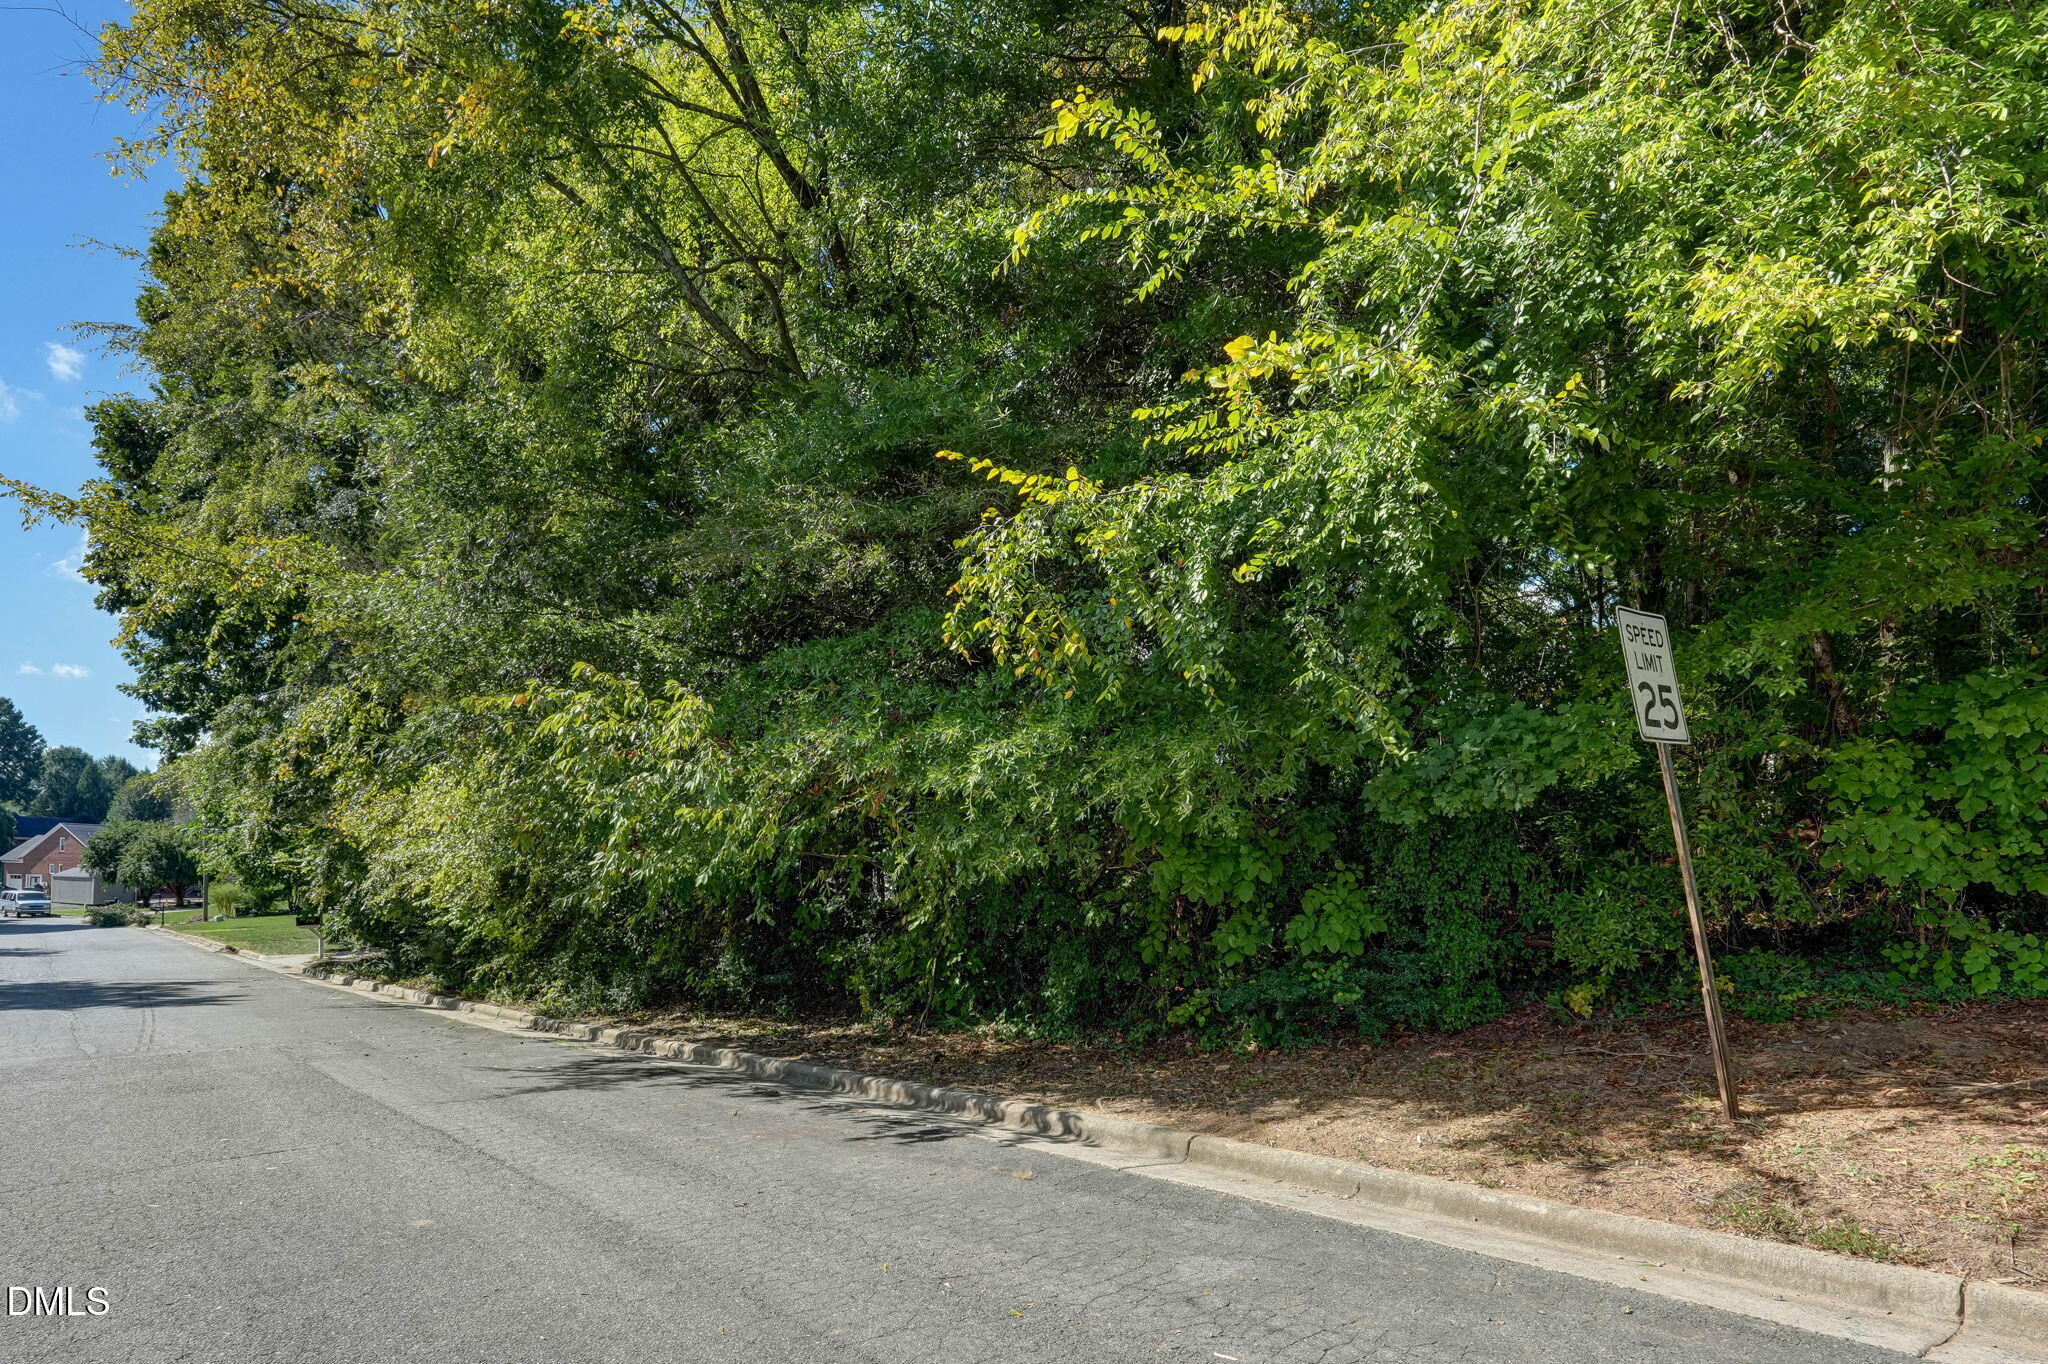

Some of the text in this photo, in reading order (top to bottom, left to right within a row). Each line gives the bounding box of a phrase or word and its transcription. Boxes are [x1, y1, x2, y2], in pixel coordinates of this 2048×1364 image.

[1625, 623, 1664, 648] SPEED
[1634, 651, 1663, 674] LIMIT
[1637, 681, 1679, 730] 25
